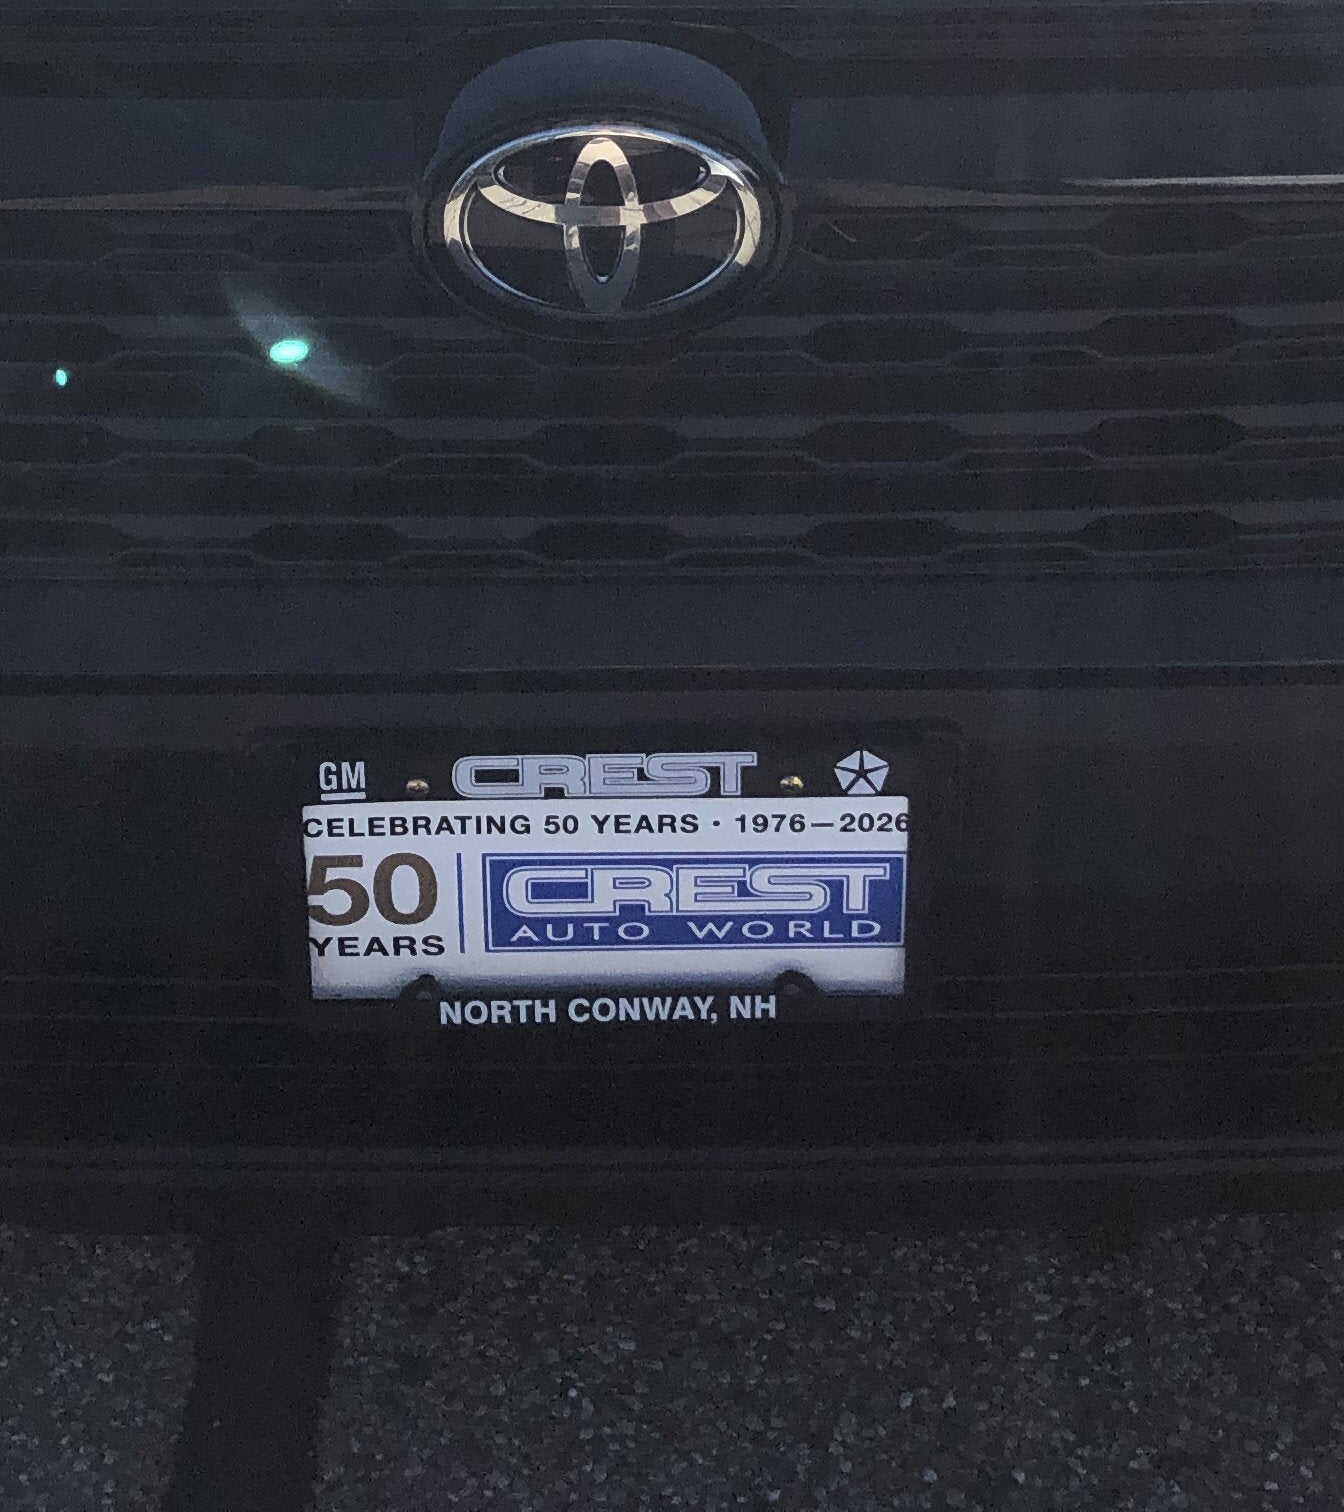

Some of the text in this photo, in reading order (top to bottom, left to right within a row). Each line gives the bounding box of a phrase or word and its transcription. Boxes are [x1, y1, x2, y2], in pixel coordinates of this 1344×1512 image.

[319, 761, 366, 791] GM
[452, 752, 757, 798] CREST
[304, 815, 531, 838] CELEBRATING
[544, 814, 578, 835] 50
[591, 814, 699, 835] YEARS
[308, 852, 438, 926] 50
[503, 863, 890, 916] CREST
[309, 934, 445, 957] YEARS
[510, 920, 881, 942] AUTO WORLD
[440, 995, 776, 1025] NORTH CONWAY, NH
